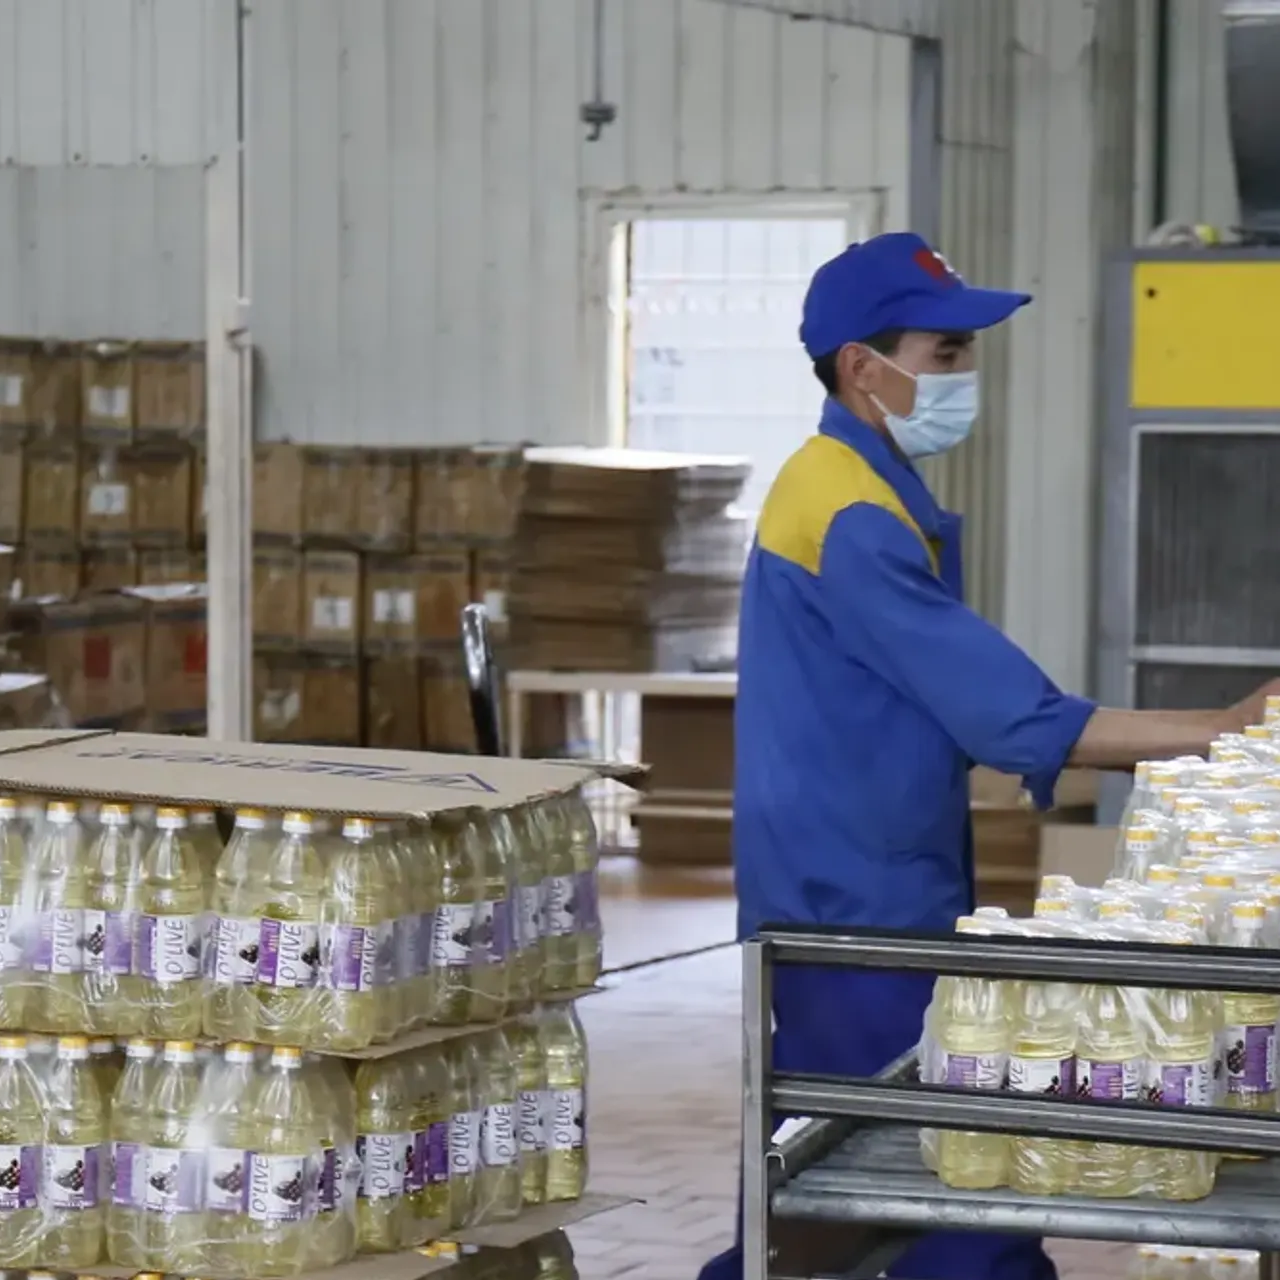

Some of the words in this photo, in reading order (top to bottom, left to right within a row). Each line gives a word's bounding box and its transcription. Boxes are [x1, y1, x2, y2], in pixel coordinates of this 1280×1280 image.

[55, 911, 75, 967] O'LIVE
[165, 918, 184, 975] O'LIVE
[280, 923, 302, 981] O'LIVE
[434, 905, 452, 960] O'LIVE
[452, 1114, 470, 1168] O'LIVE
[496, 1105, 512, 1159] O'LIVE
[520, 1092, 538, 1145] O'LIVE
[555, 1094, 570, 1145] O'LIVE
[251, 1156, 269, 1214] O'LIVE
[372, 1135, 392, 1191] O'LIVE
